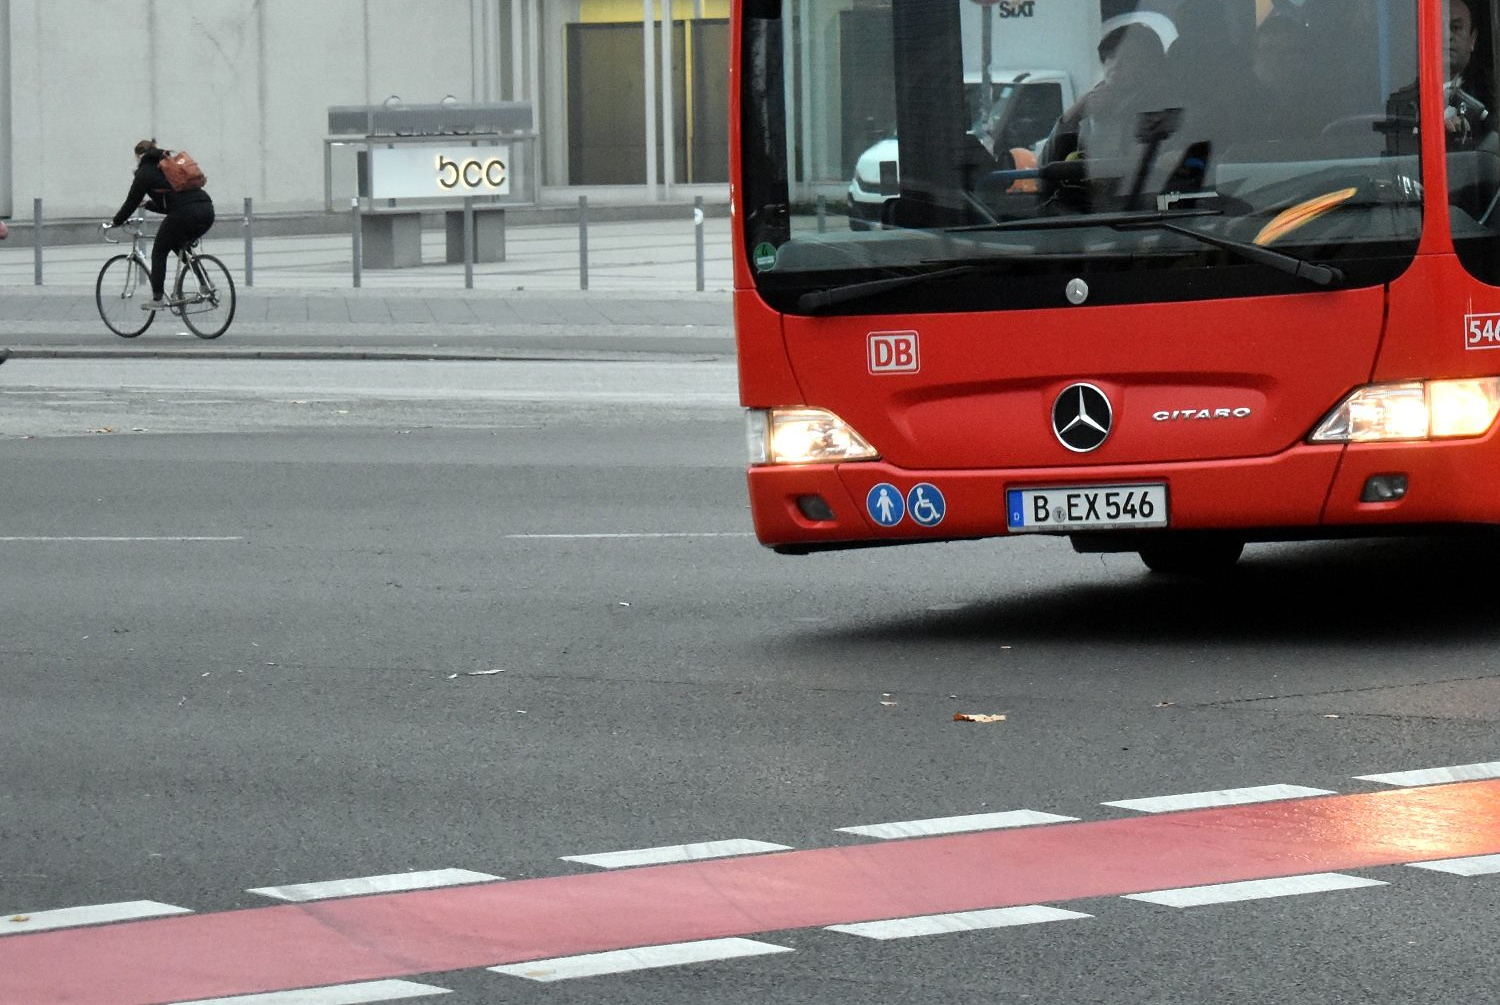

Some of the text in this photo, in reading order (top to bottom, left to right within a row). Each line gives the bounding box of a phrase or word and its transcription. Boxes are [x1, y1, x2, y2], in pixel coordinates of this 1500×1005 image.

[438, 154, 506, 189] bcc
[873, 338, 914, 368] DB
[1151, 406, 1252, 421] CITARO
[1013, 512, 1020, 521] D
[1033, 490, 1154, 523] B EX 546
